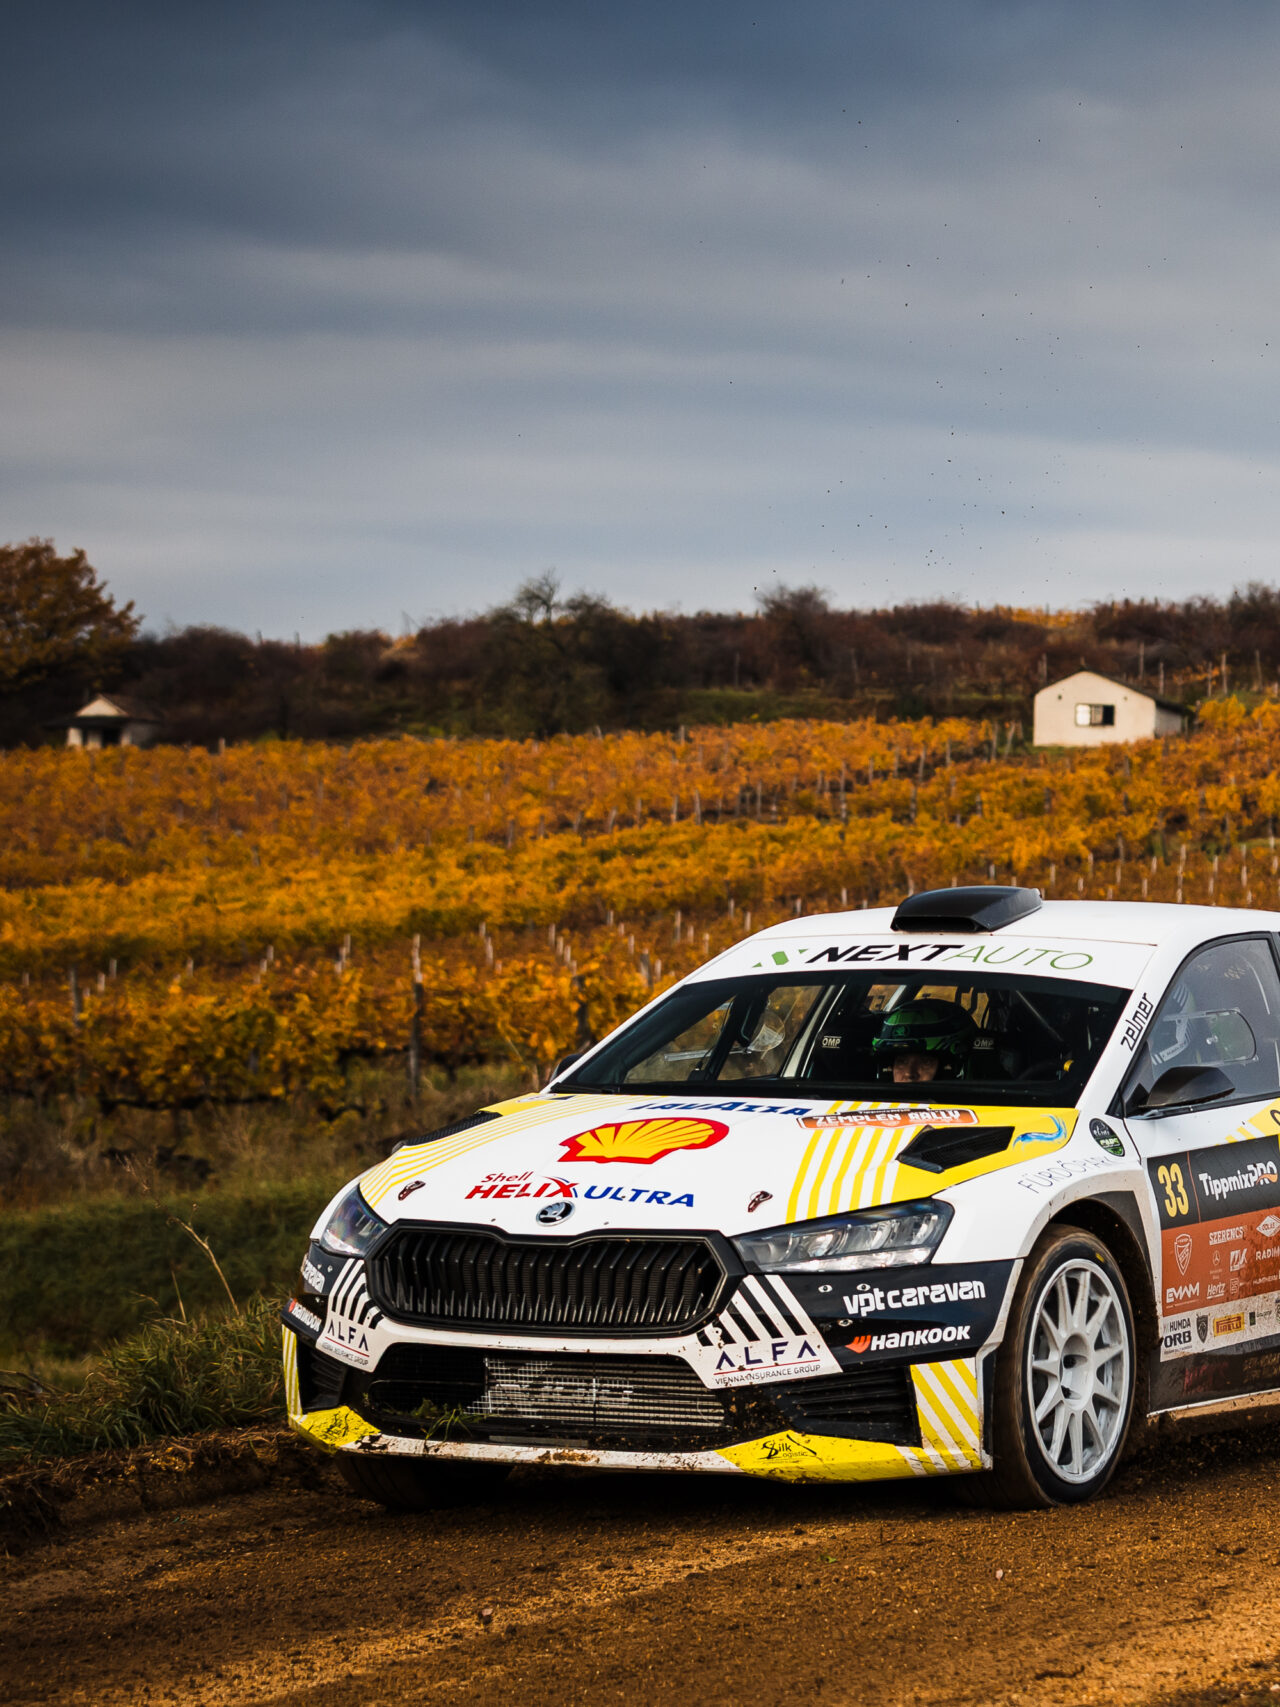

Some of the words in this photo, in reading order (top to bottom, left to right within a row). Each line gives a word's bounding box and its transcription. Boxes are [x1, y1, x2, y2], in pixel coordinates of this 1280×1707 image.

[1120, 992, 1154, 1051] zelmer
[822, 1037, 842, 1048] OMP
[464, 1177, 580, 1199] HELIX
[583, 1185, 695, 1207] ULTRA
[481, 1171, 534, 1183] Shell
[1157, 1163, 1189, 1217] 33
[1198, 1161, 1278, 1200] TippmixPRO
[1207, 1281, 1226, 1297] Hertz
[327, 1318, 369, 1352] ALFA
[1169, 1318, 1191, 1332] HUMDA
[715, 1340, 817, 1370] ALFA
[793, 1364, 821, 1375] GROUP
